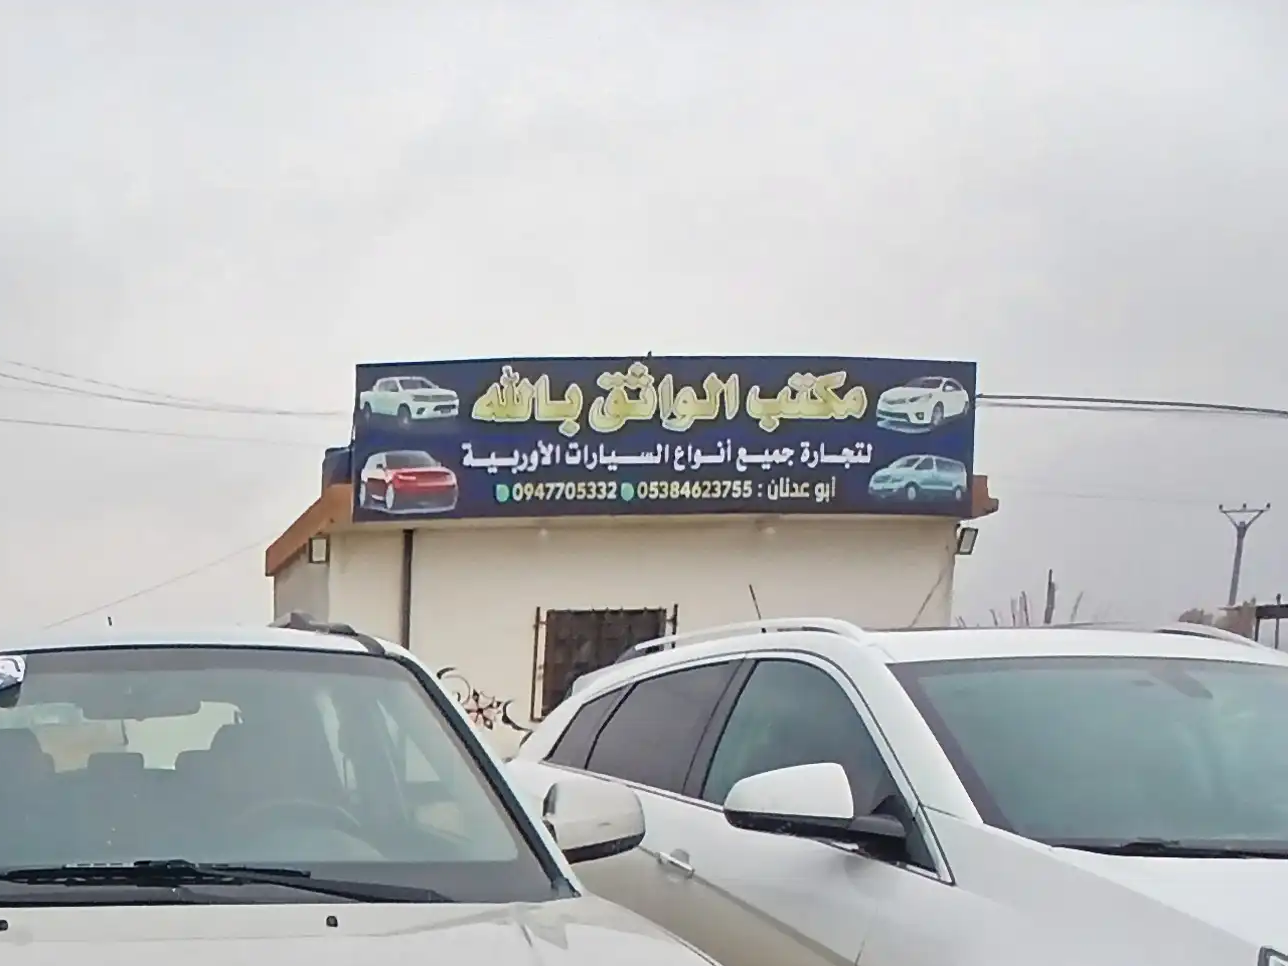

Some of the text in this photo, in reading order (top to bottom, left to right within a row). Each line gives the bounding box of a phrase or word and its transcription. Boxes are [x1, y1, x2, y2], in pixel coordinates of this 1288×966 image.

[472, 361, 868, 438] مكتب الواثق بالله
[461, 439, 873, 474] لتجارة جميع أنواع السيارات الأوربية
[512, 481, 617, 501] 0947705332
[637, 480, 753, 499] 05384623755
[767, 477, 810, 500] عدنان
